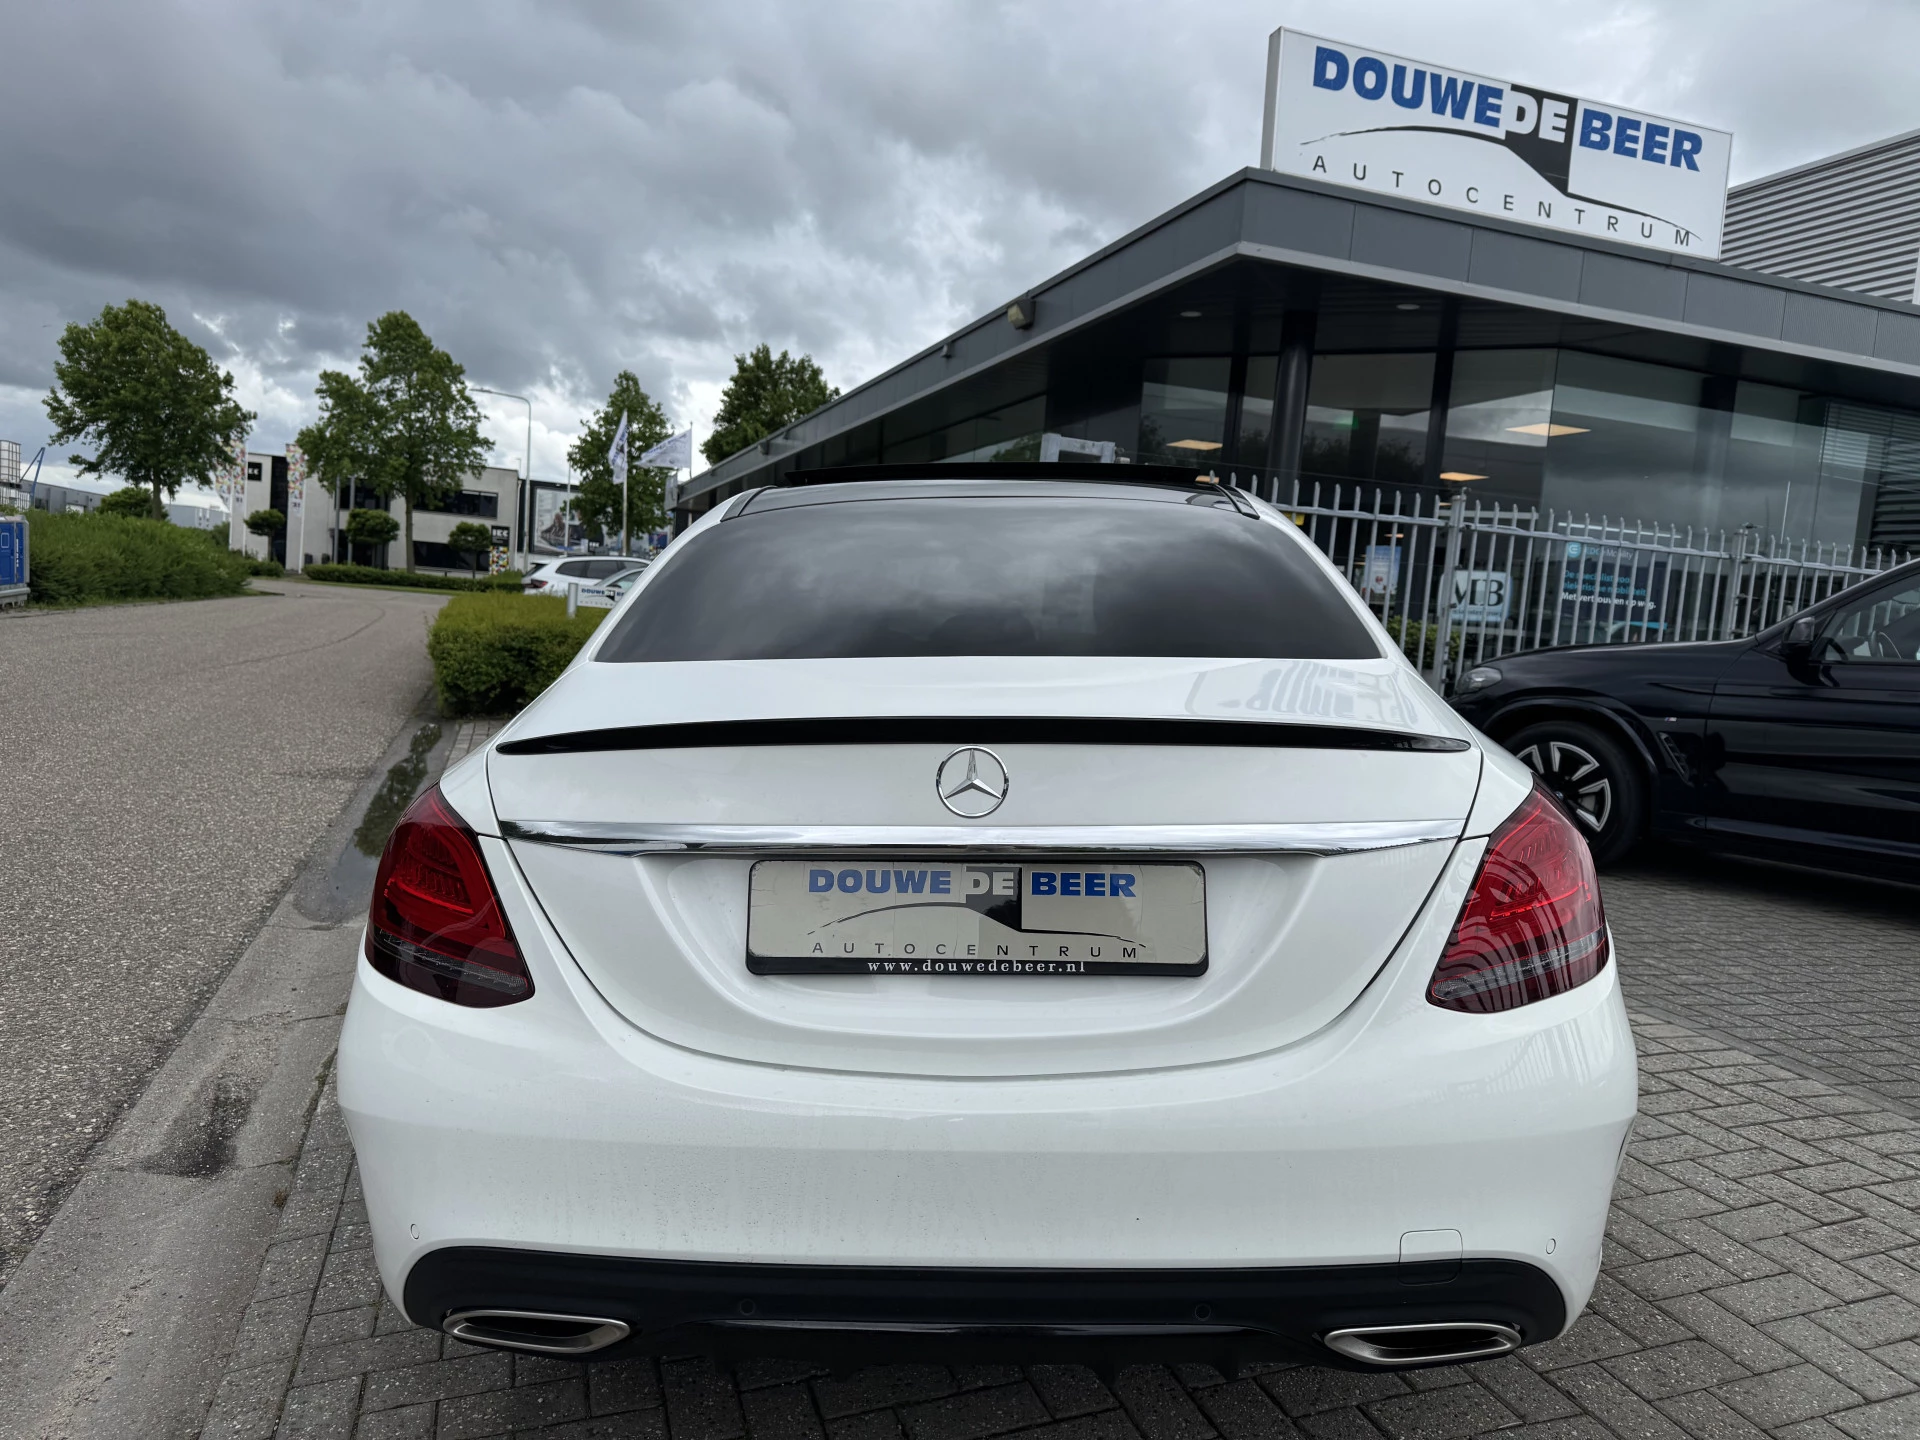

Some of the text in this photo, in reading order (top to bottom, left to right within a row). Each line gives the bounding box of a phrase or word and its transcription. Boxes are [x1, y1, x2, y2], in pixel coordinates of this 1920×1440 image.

[1313, 46, 1703, 171] DOUWE DE BEER
[1313, 156, 1690, 247] AUTOCENTRUM
[1561, 592, 1577, 601] Met
[808, 869, 1137, 898] DOUWE DE BEER
[812, 942, 1137, 959] AUTOCENTRUM
[867, 959, 1087, 974] www.douwedebeer.nl
